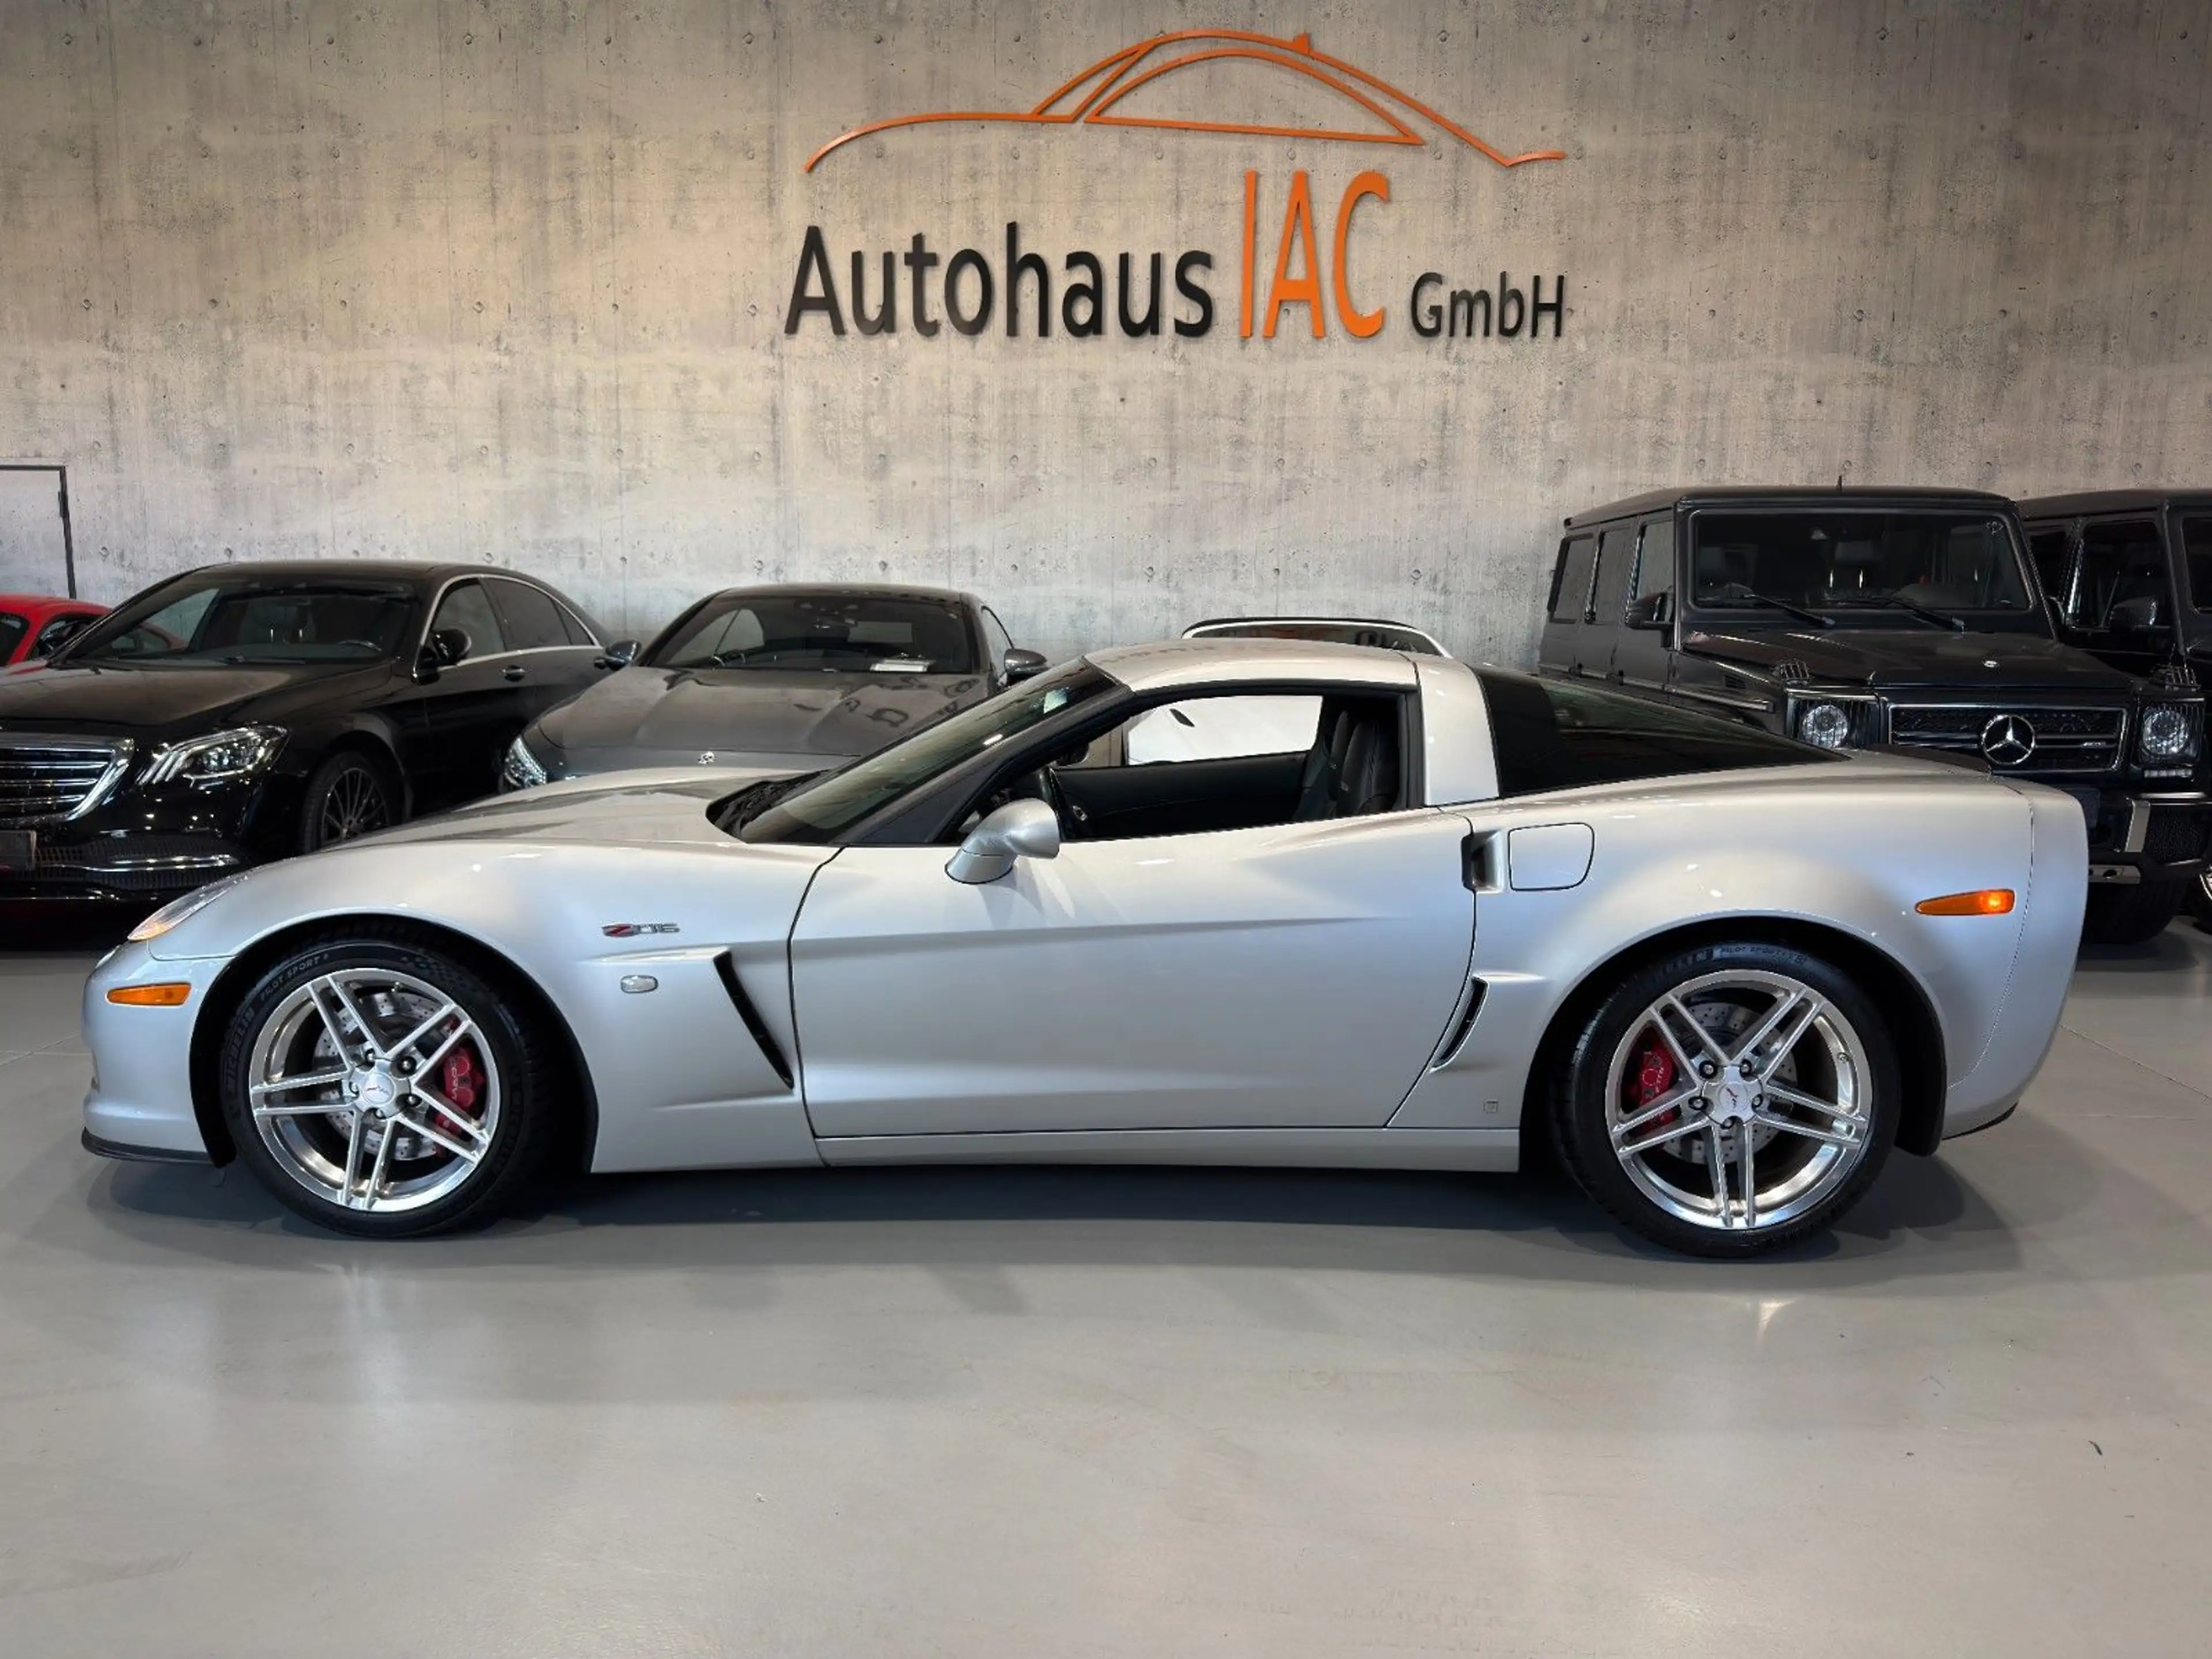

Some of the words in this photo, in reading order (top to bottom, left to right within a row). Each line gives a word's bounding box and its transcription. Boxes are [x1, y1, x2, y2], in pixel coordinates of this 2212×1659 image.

[785, 222, 1213, 338] Autohaus
[1240, 170, 1389, 339] IAC
[1410, 271, 1565, 338] GmbH
